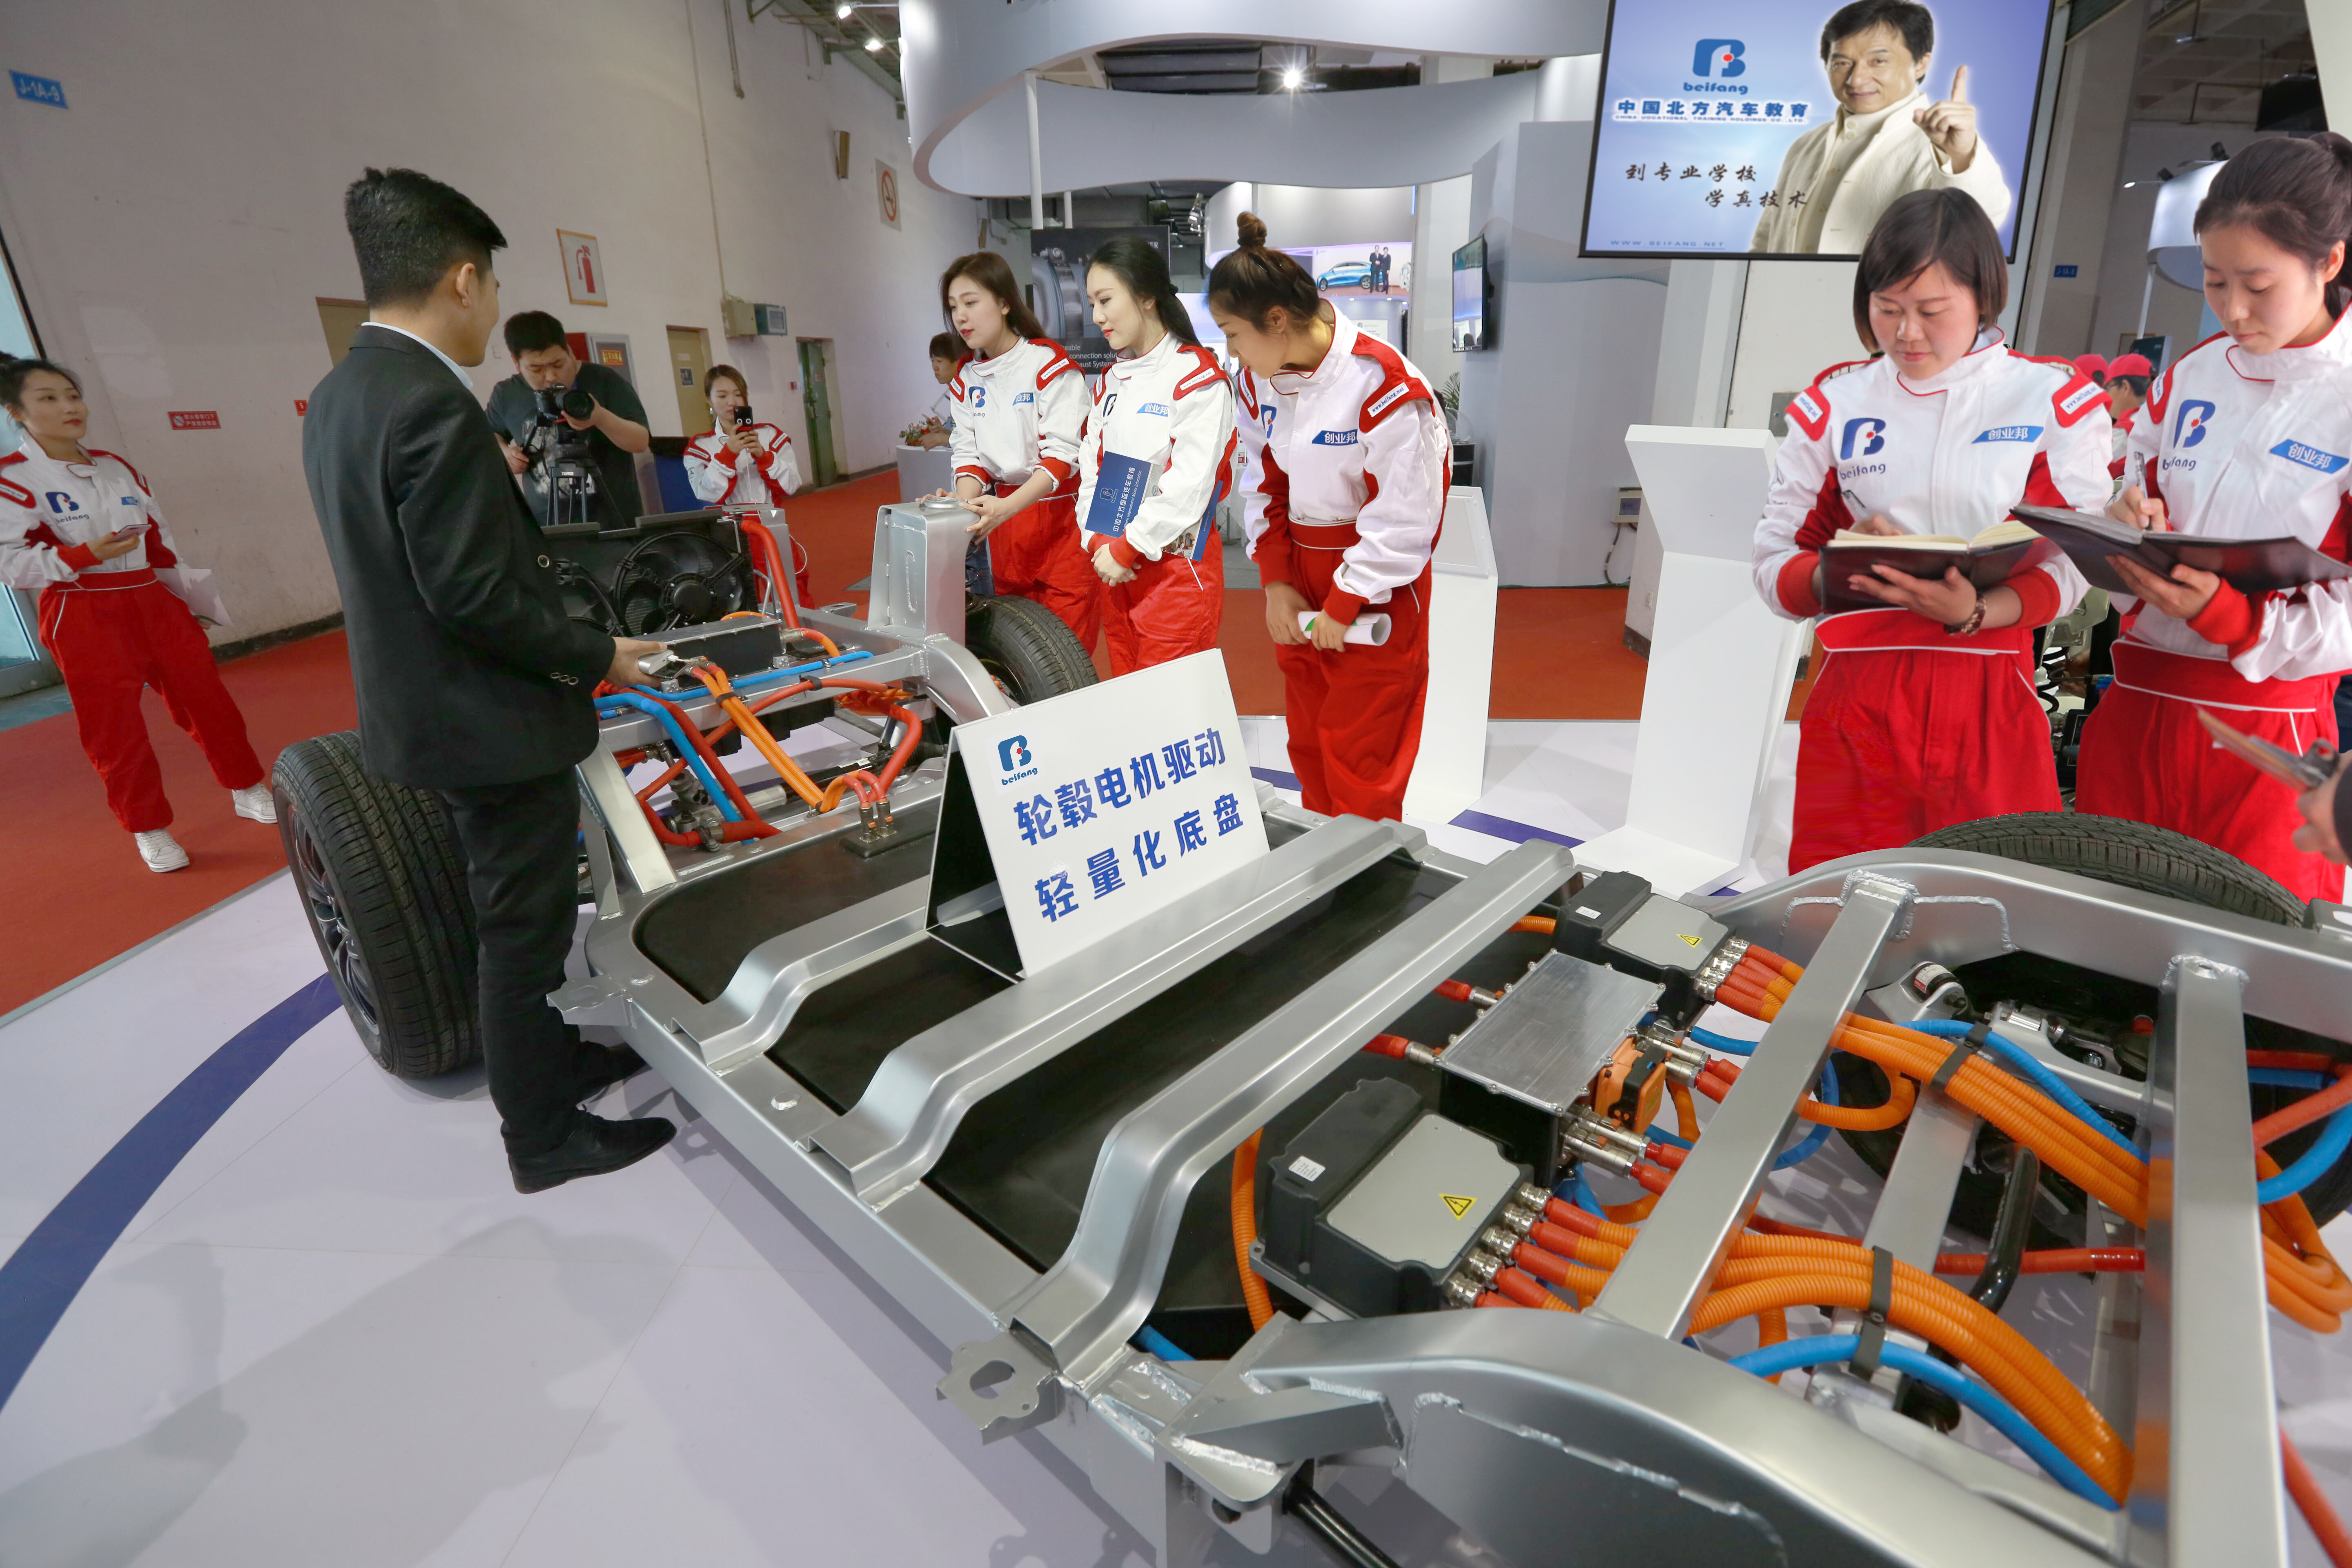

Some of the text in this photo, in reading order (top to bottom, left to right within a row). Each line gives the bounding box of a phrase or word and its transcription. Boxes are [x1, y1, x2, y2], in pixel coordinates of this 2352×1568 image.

[1683, 82, 1748, 95] beifang
[1618, 100, 1808, 117] 中国北方汽车教育
[1626, 162, 1757, 182] 到专业学校
[1705, 189, 1807, 208] 学真技术
[1372, 387, 1405, 413] www.beifang.net
[1324, 432, 1356, 444] 创业邦
[1988, 427, 2029, 440] 创业邦
[2287, 443, 2333, 469] 创业邦
[1839, 463, 1886, 480] beifang
[1113, 467, 1136, 532] 中国北方国际汽车教育
[1127, 497, 1135, 517] International
[1001, 767, 1038, 786] beifang
[1013, 727, 1226, 846] 轮毂电机驱动
[1034, 793, 1244, 923] 轻量化底盘
